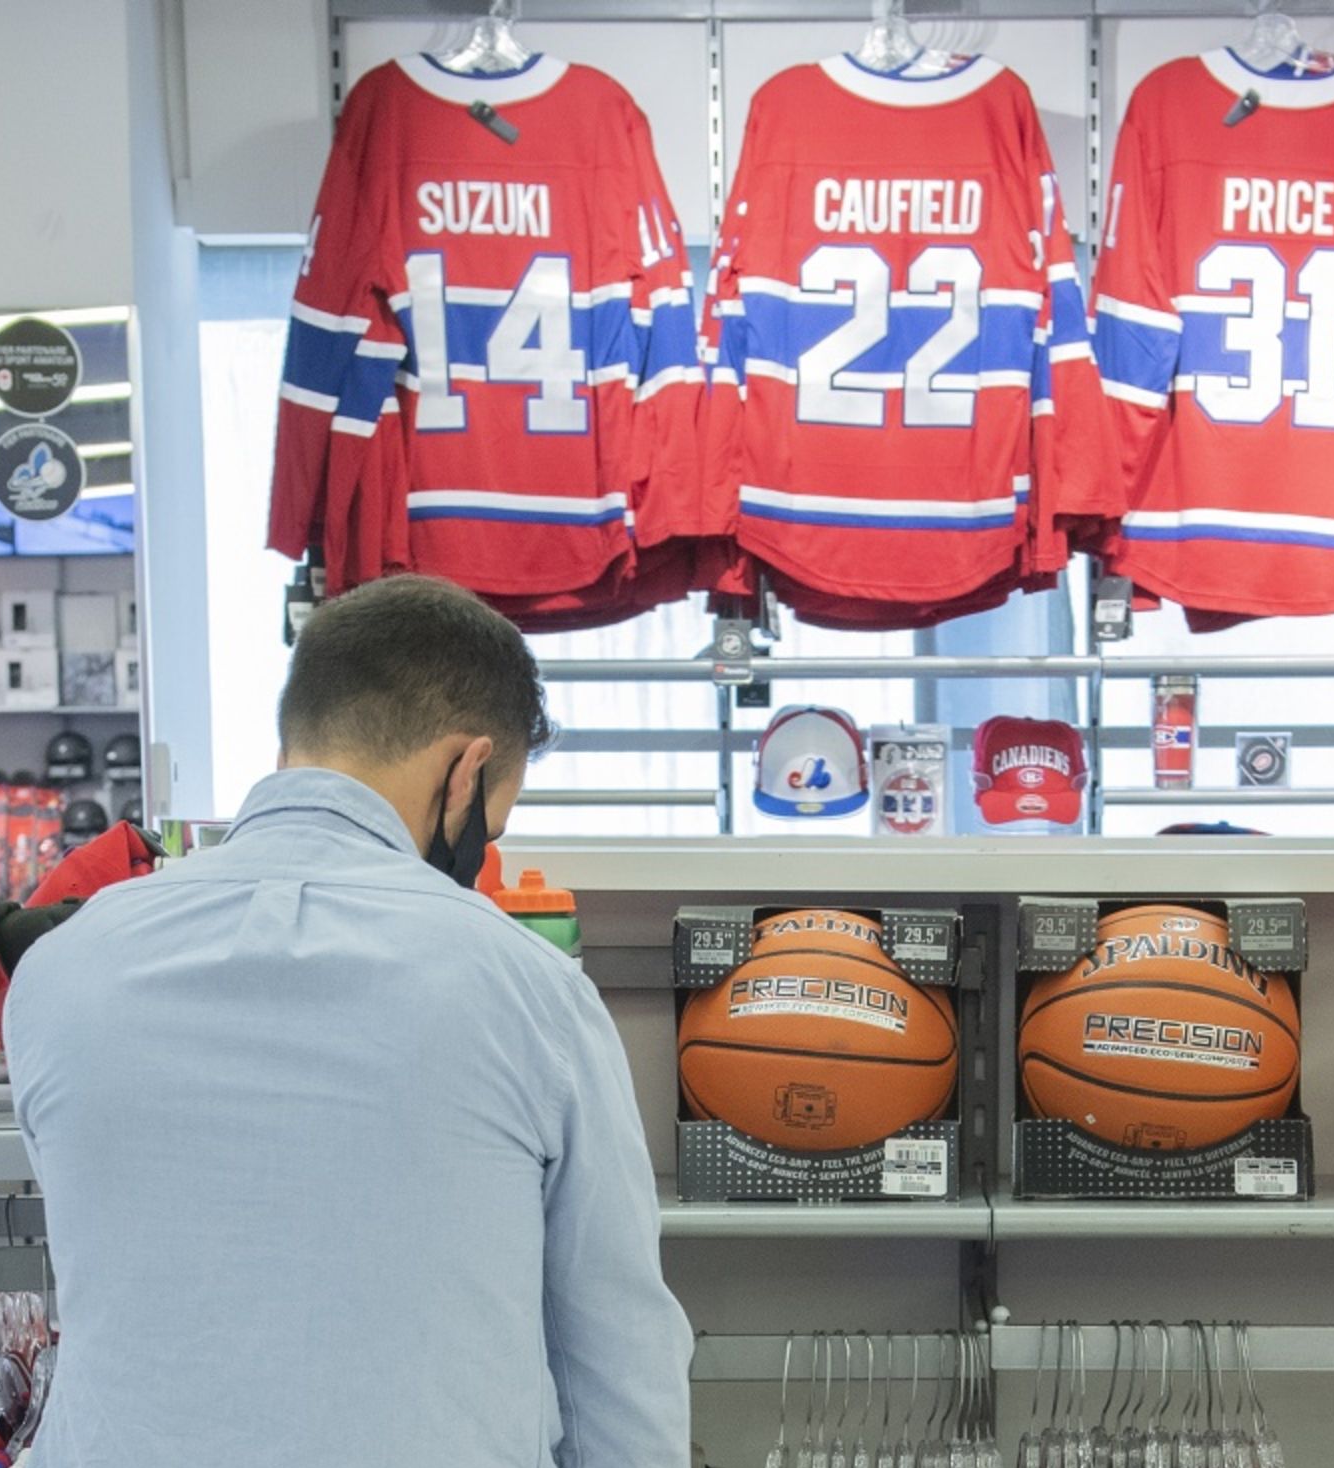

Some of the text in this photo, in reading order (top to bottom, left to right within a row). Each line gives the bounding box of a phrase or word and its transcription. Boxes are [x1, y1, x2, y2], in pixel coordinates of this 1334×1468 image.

[418, 182, 550, 237] SUZUKI
[813, 178, 982, 236] CAUFIELD
[1222, 177, 1334, 237] PRICE
[405, 251, 589, 434] 14
[797, 242, 985, 427] 22
[992, 744, 1071, 777] CANADIENS
[730, 976, 909, 1018] PRECISION
[1083, 1013, 1264, 1054] PRECISION
